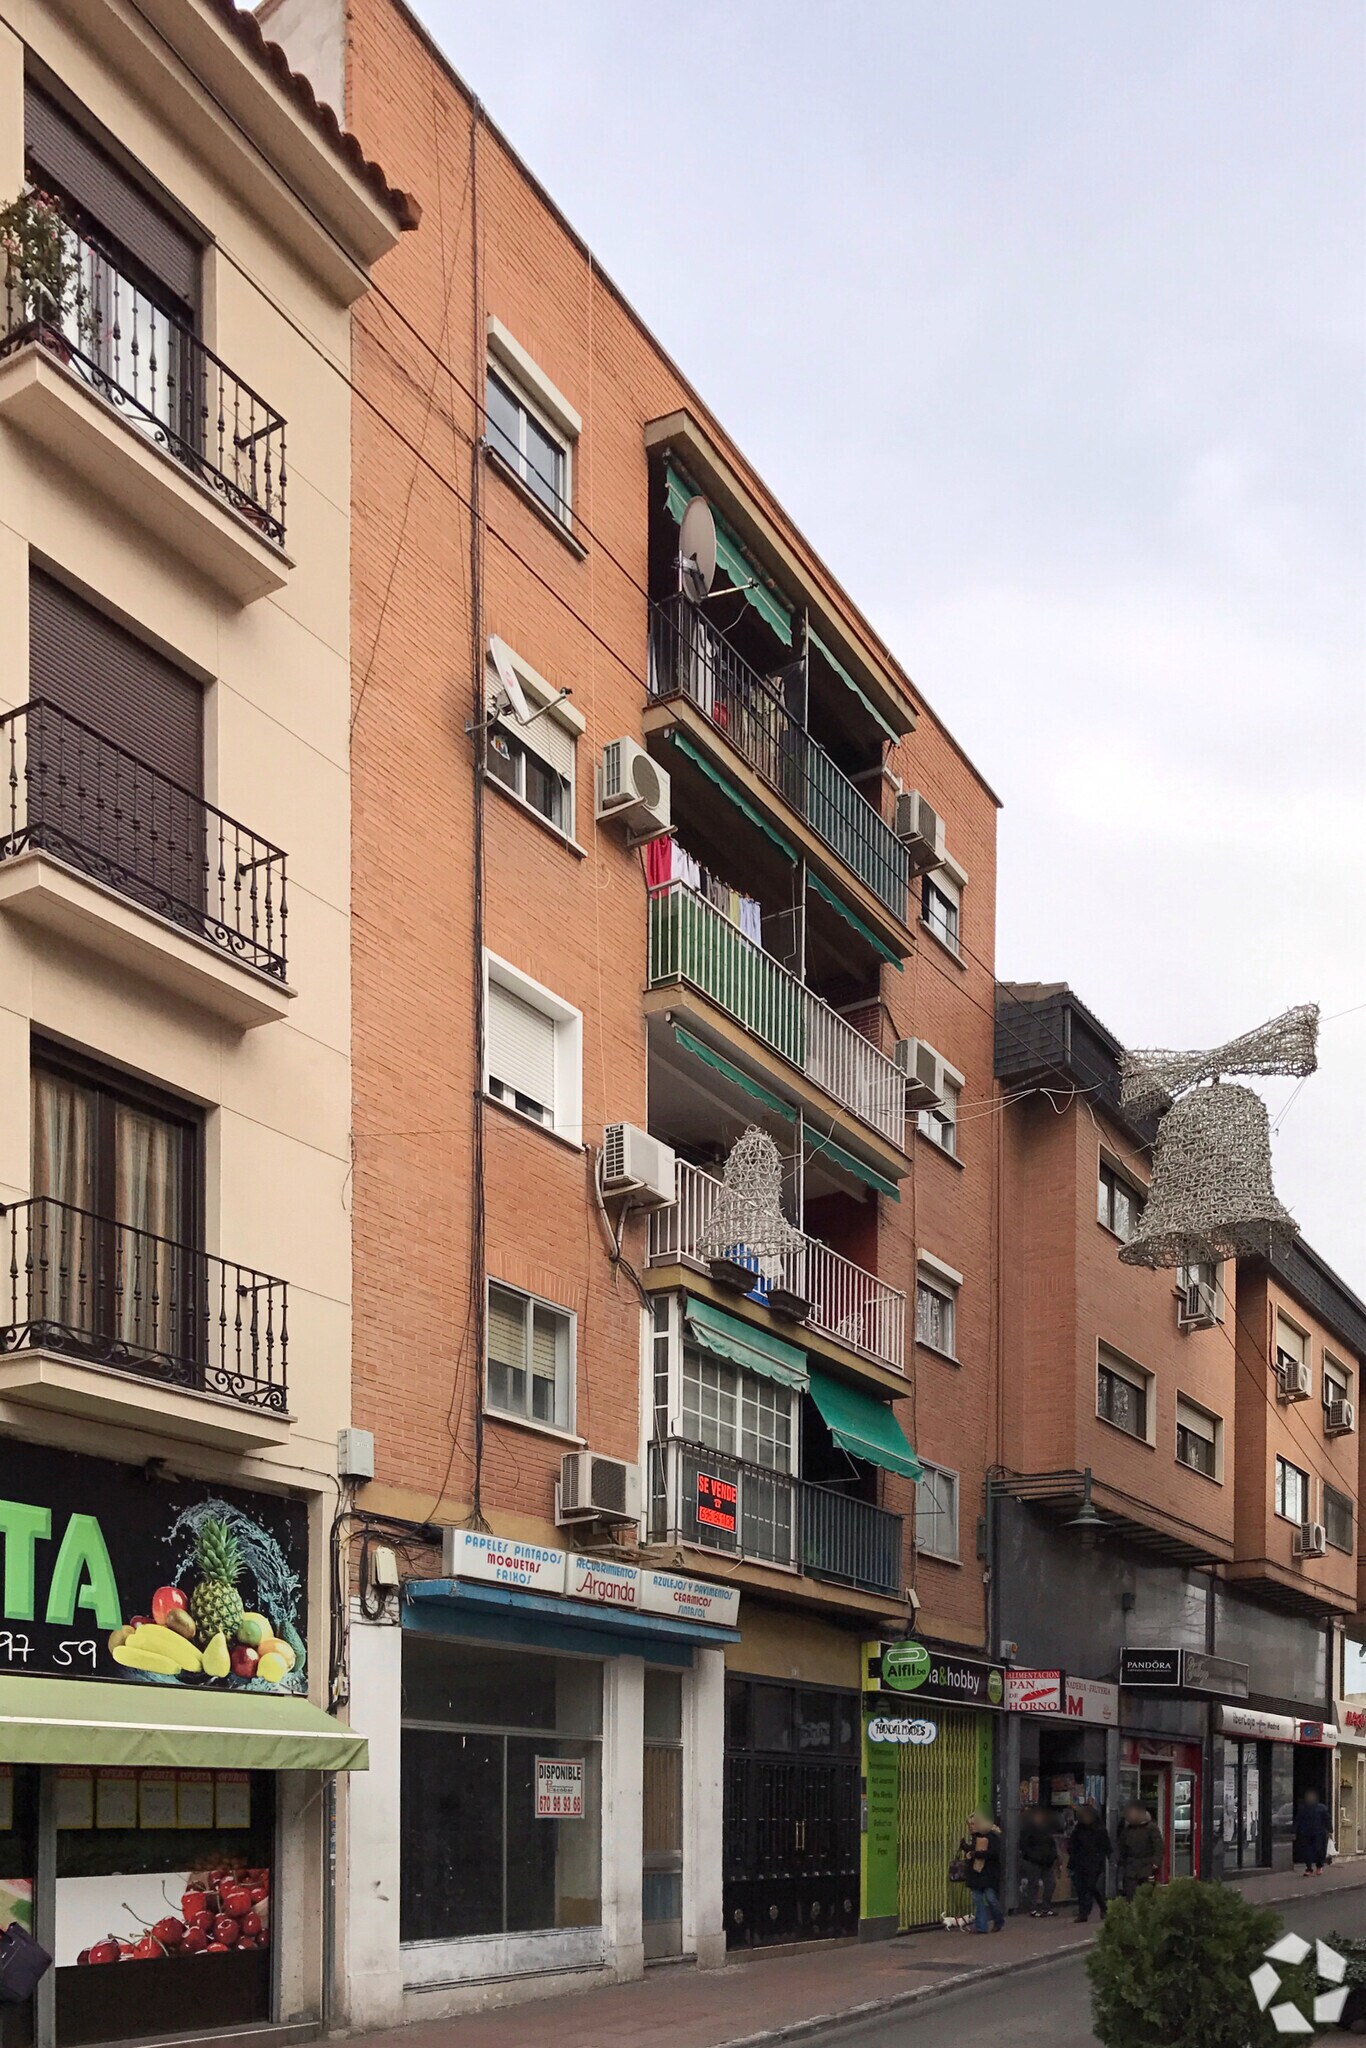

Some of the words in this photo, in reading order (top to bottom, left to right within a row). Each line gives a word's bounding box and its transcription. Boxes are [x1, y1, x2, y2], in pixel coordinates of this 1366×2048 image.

[699, 1475, 709, 1494] SE
[711, 1480, 737, 1504] VENDE
[465, 1535, 509, 1553] PAPELES
[515, 1546, 563, 1564] PINTADOS
[487, 1553, 542, 1573] MOQUETAS
[576, 1572, 635, 1603] Arganda
[653, 1576, 687, 1591] AZULEJOS
[688, 1582, 693, 1592] Y
[694, 1584, 733, 1600] PAVIMENTOS
[53, 1640, 97, 1668] 59
[1007, 1671, 1060, 1679] ALIMENTACION
[1009, 1681, 1035, 1689] PAN
[1009, 1702, 1057, 1711] HORNO
[539, 1764, 581, 1780] DISPONIBLE
[540, 1795, 550, 1811] 670
